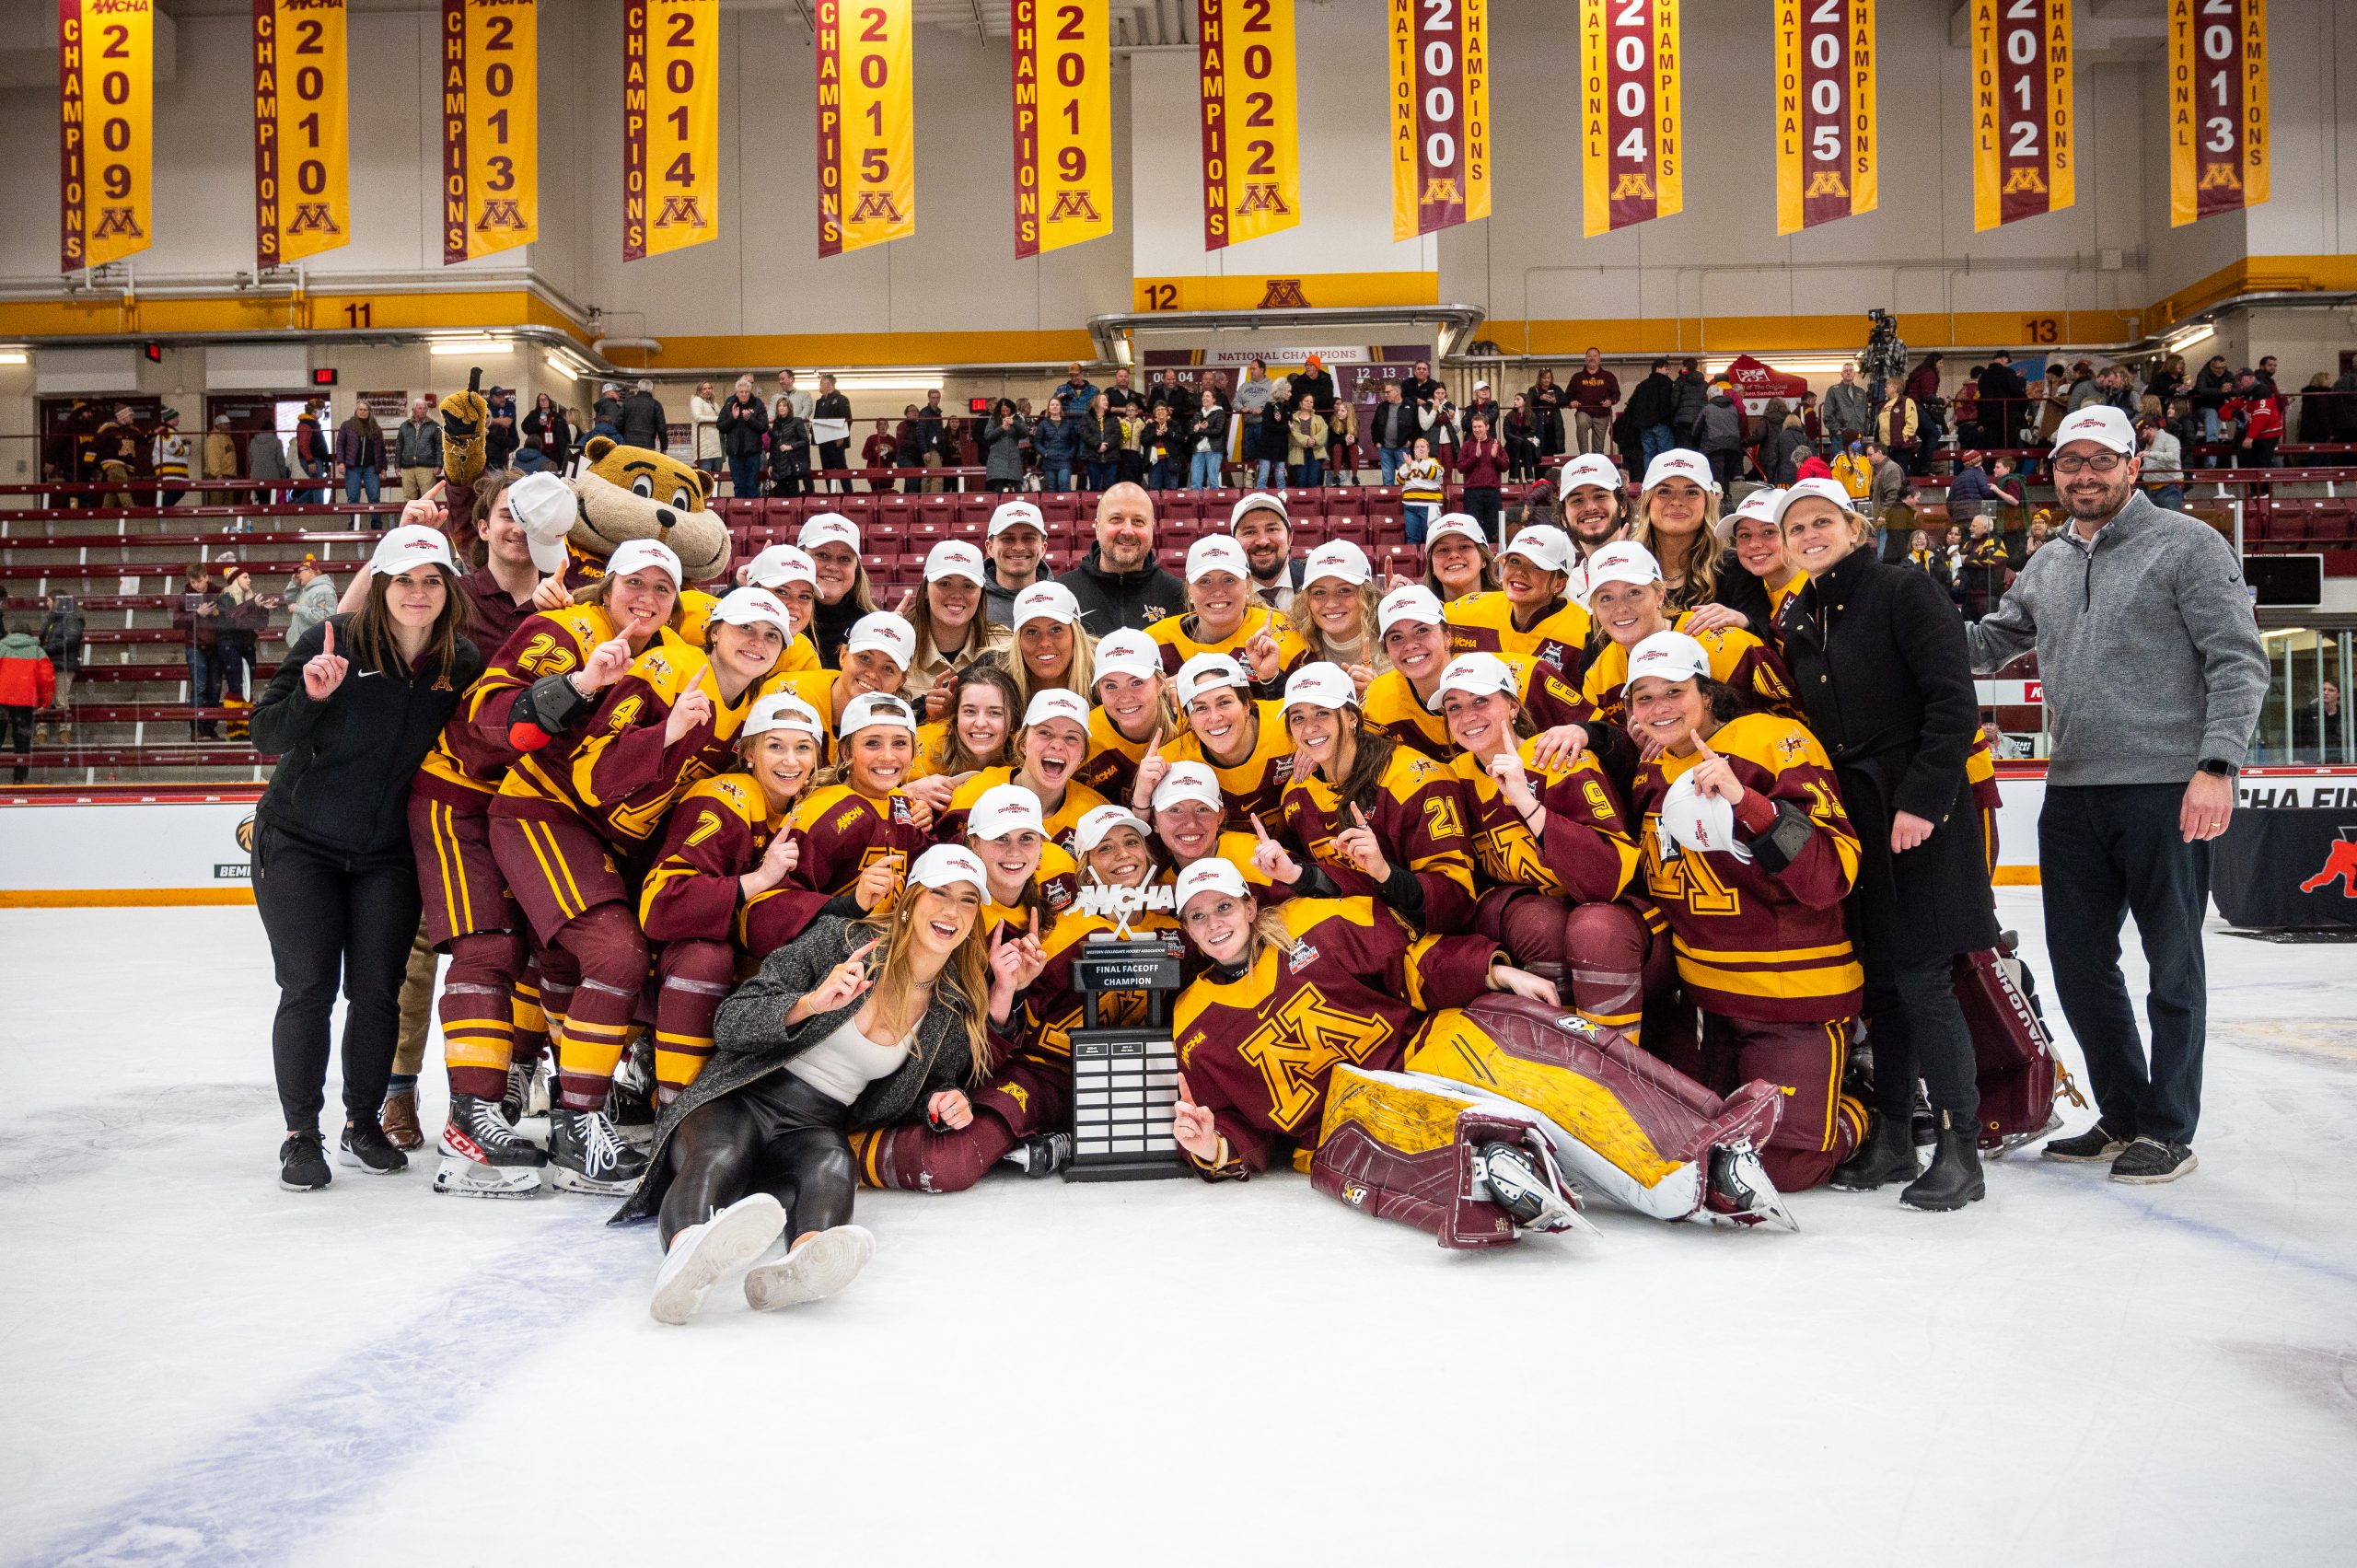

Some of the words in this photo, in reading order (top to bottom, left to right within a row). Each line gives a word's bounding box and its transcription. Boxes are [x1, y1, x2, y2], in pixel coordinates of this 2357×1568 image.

[1242, 0, 1274, 175] 2022
[1396, 0, 1410, 162] NATIONAL
[1424, 0, 1455, 168] 2000
[1468, 0, 1482, 180] CHAMPIONS
[1616, 0, 1647, 162] 2004
[1782, 0, 1795, 154] ATIONAL
[1810, 0, 1840, 161] 2005
[1855, 0, 1869, 173] HAMPIONS
[2007, 0, 2039, 156] 2012
[486, 16, 514, 192] 2013
[665, 12, 695, 188] 2014
[860, 8, 889, 182] 2015
[1056, 6, 1086, 182] 2019
[102, 25, 132, 200] 2009
[296, 20, 327, 195] 2010
[1204, 0, 1225, 236] CHAMPIONS
[257, 16, 276, 254] CHAMPIONS
[447, 12, 465, 250] CHAMPIONS
[626, 7, 644, 248] CHAMPIONS
[819, 2, 838, 242] CHAMPIONS
[1016, 2, 1036, 242] CHAMPIONS
[64, 19, 82, 258] CHAMPIONS
[1144, 284, 1178, 310] 12
[344, 303, 370, 328] 11
[2026, 319, 2058, 343] 13
[1218, 352, 1279, 362] NATIONAL
[317, 369, 333, 382] EXIT
[1178, 372, 1194, 383] 04
[1356, 367, 1371, 378] 12
[1382, 367, 1396, 378] 13
[2259, 399, 2267, 408] 9
[2071, 421, 2107, 431] CHAMPIONS
[1571, 466, 1599, 476] CHAMPIONS
[1663, 459, 1696, 470] CHAMPIONS
[403, 541, 439, 551] CHAMPIONS
[944, 554, 971, 563] CHAMPIONS
[781, 560, 809, 571] CHAMPIONS
[1296, 556, 1328, 565] CHAMPIONS
[1596, 556, 1630, 570] CHAMPIONS
[750, 601, 781, 616] CHAMPIONS
[1026, 596, 1054, 605] CHAMPIONS
[1387, 600, 1416, 613] CHAMPIONS
[873, 628, 901, 643] CHAMPIONS
[517, 633, 576, 678] 22
[1105, 648, 1135, 657] CHAMPIONS
[1635, 650, 1669, 662] CHAMPIONS
[1292, 680, 1322, 691] CHAMPIONS
[1445, 667, 1475, 681] CHAMPIONS
[609, 695, 644, 731] 4
[998, 805, 1030, 814] CHAMPIONS
[1583, 780, 1616, 820] 9
[683, 810, 723, 847] 7
[1423, 796, 1465, 841] 21
[946, 860, 978, 874] CHAMPIONS
[1188, 874, 1220, 885] CHAMPIONS
[1096, 966, 1121, 974] FINAL
[1122, 964, 1159, 972] FACEOFF
[1104, 977, 1152, 986] CHAMPION
[1991, 960, 2046, 1057] VAUGHN
[444, 1125, 484, 1161] CCM
